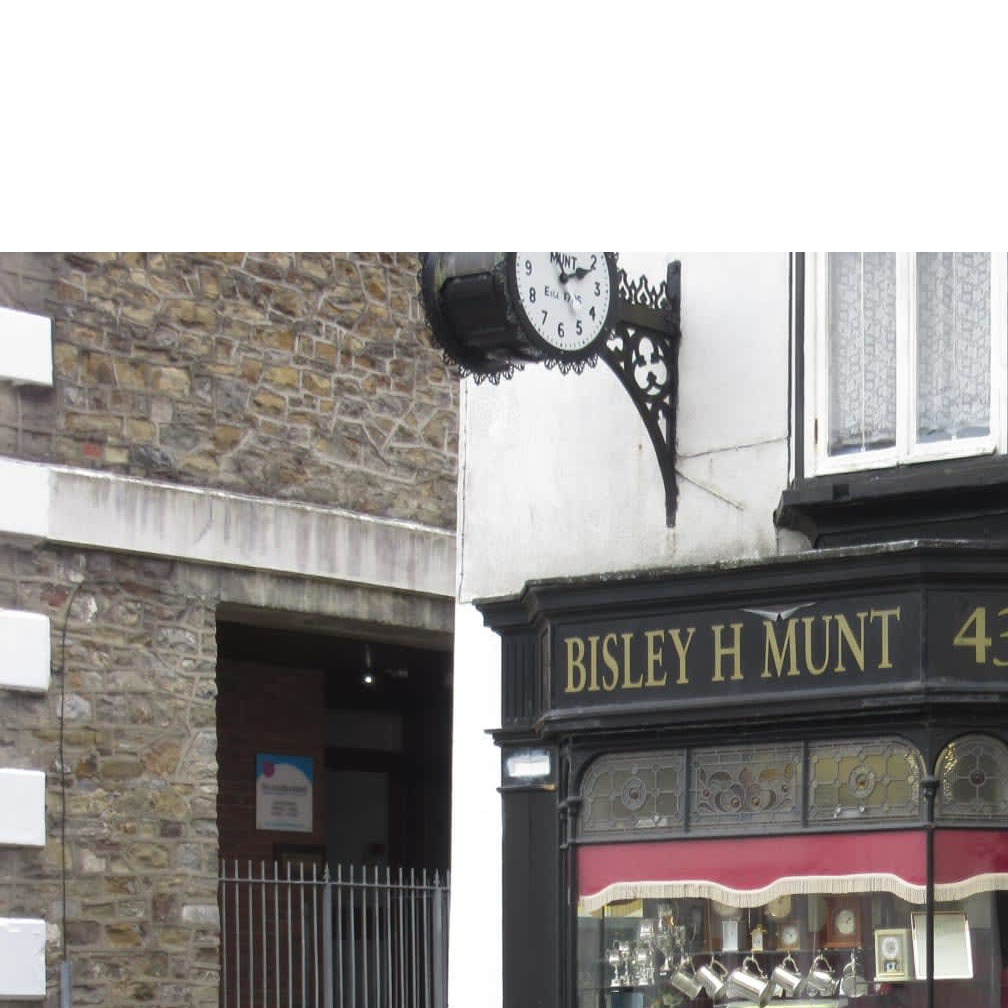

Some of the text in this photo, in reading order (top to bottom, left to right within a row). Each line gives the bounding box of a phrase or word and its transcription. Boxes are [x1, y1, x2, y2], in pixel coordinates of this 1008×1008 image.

[525, 260, 532, 276] 9
[529, 287, 536, 303] 8
[594, 282, 601, 297] 3
[541, 310, 548, 325] 7
[588, 306, 596, 321] 4
[557, 322, 565, 338] 6
[575, 320, 583, 336] 5
[564, 606, 901, 694] BISLEY H MUNT
